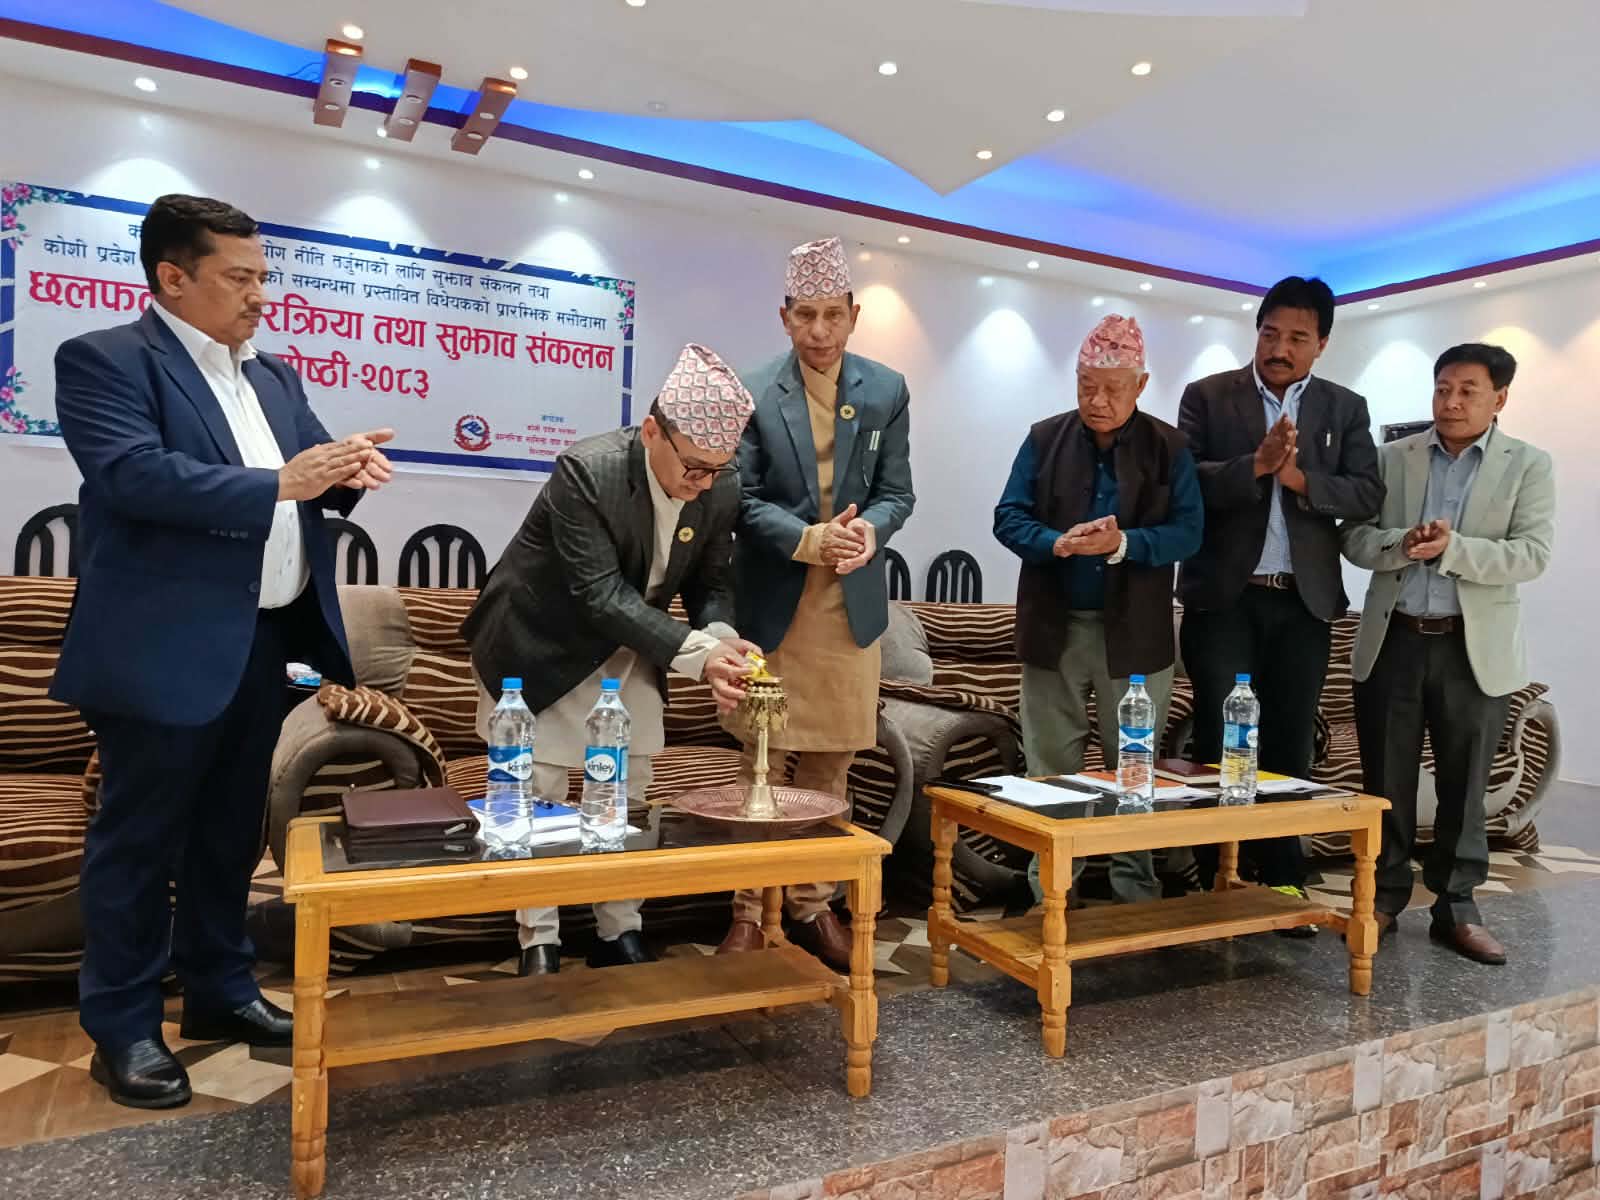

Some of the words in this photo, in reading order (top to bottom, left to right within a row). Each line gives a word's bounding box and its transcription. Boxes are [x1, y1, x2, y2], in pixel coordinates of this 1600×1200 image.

[43, 235, 88, 258] कोशी
[96, 243, 136, 264] प्रदेश
[295, 246, 325, 265] नीति
[395, 263, 426, 280] लागि
[479, 275, 522, 295] संकलन
[528, 284, 551, 300] तथा
[292, 273, 355, 296] सम्बन्धमा
[364, 284, 420, 304] प्रस्तावित
[426, 288, 490, 314] विधेयकको
[373, 315, 427, 348] तथा
[436, 323, 518, 360] सुझाव
[525, 331, 615, 371] संकलन
